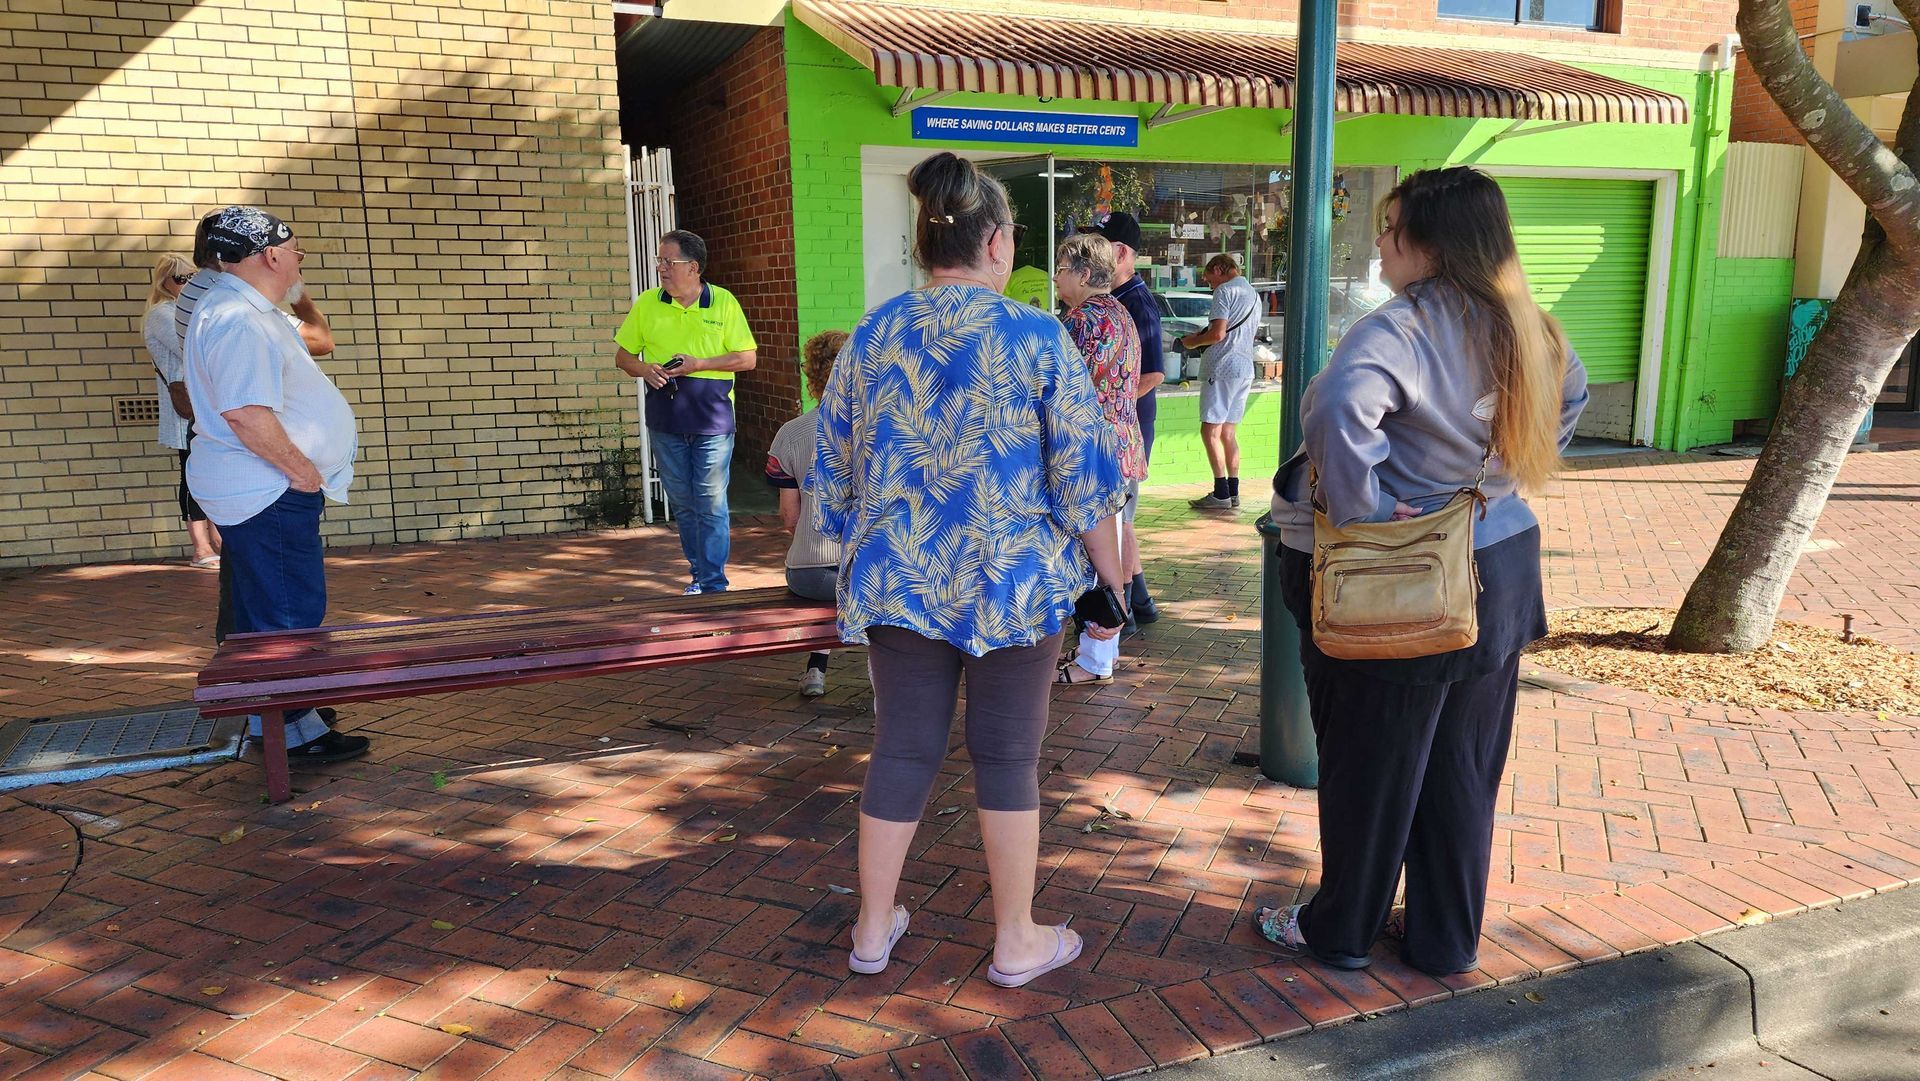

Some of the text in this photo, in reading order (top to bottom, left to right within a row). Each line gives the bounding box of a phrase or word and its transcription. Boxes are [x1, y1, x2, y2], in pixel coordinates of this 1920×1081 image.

[927, 117, 1126, 136] WHERE SAVING DOLLARS MAKES BETTER CENTS
